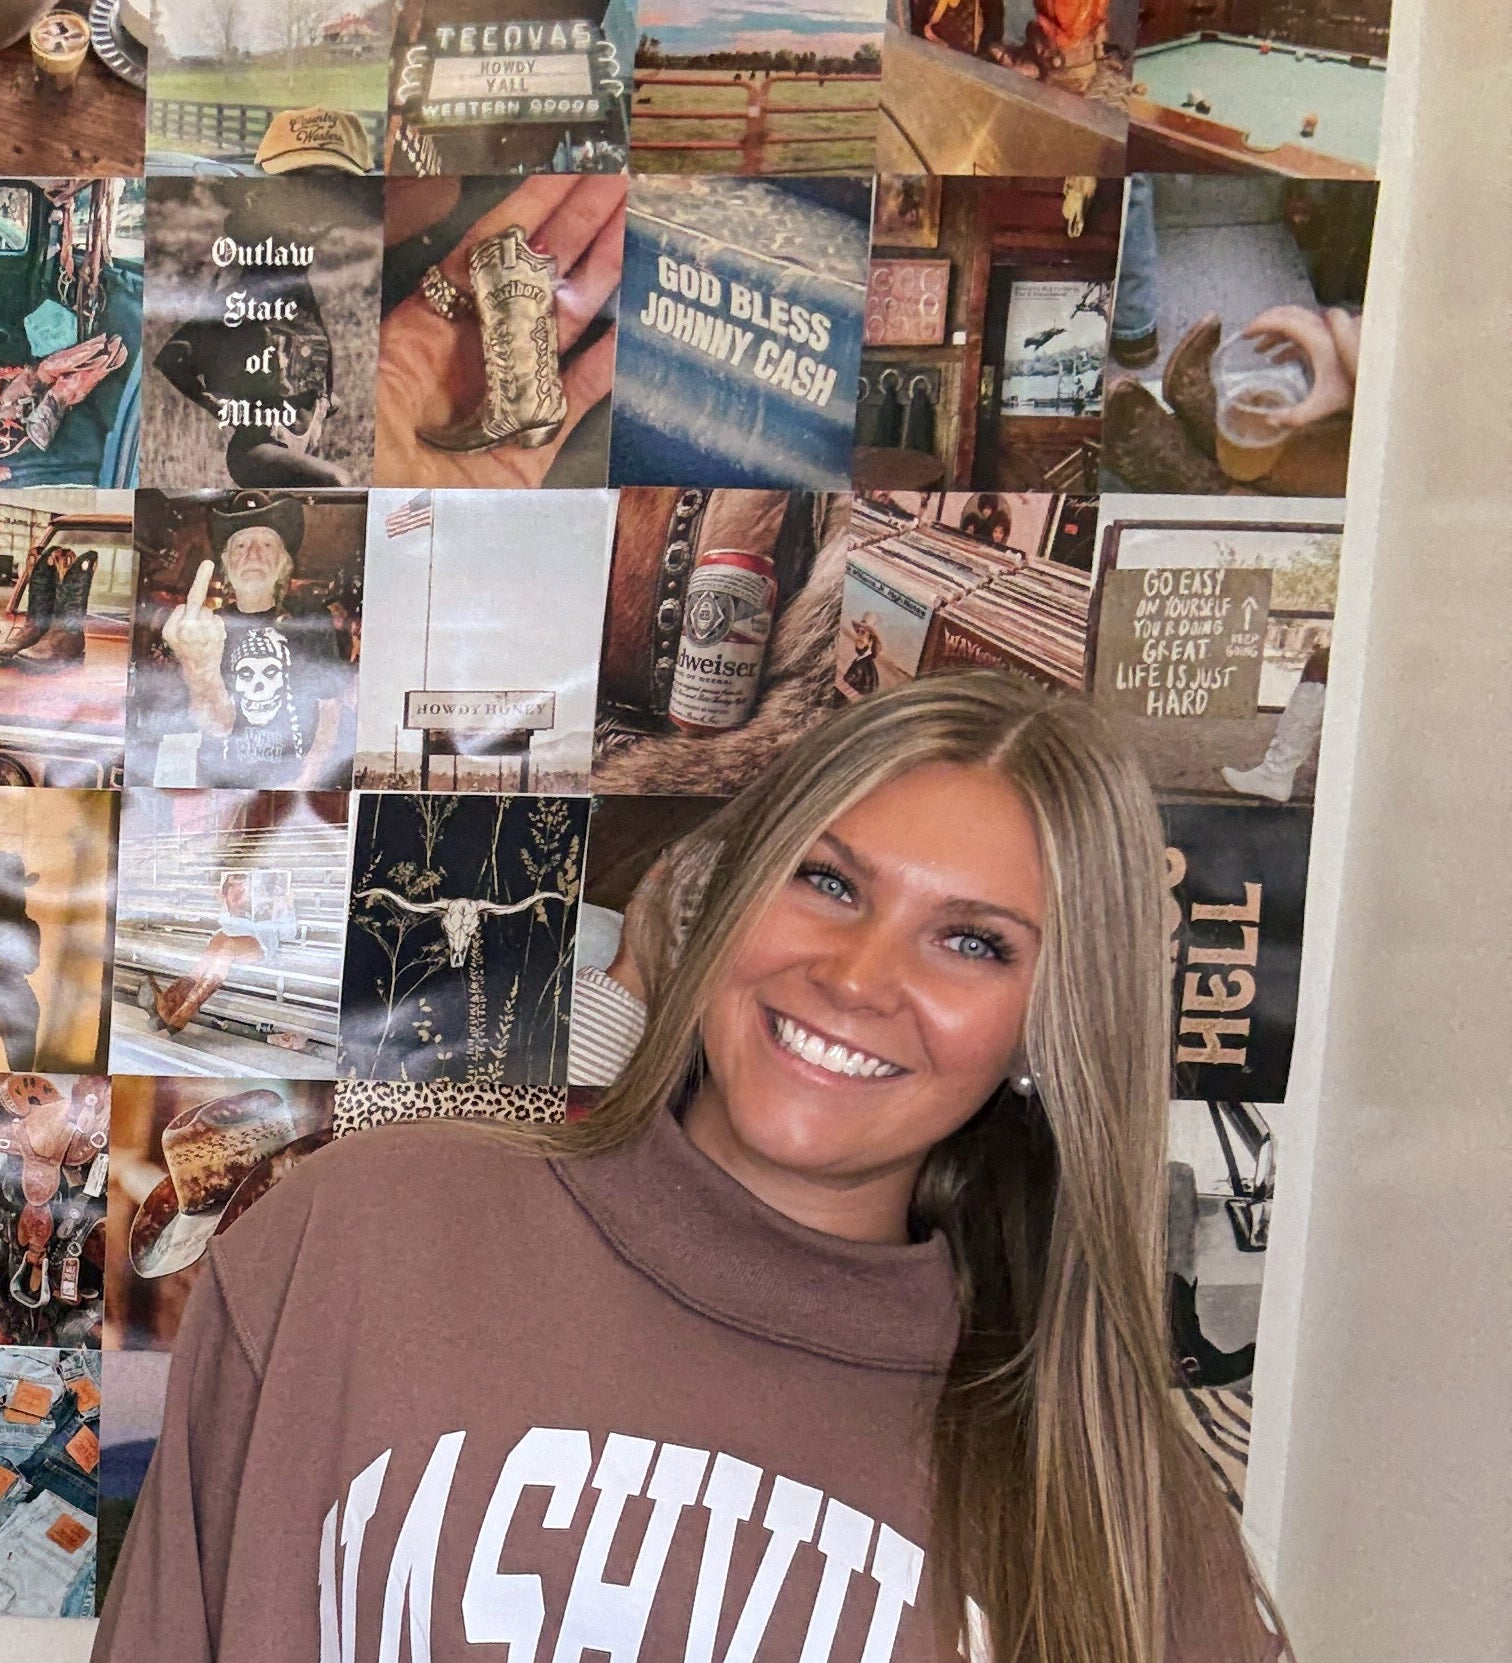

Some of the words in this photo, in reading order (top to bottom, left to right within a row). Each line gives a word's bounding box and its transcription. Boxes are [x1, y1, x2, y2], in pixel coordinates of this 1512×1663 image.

[436, 20, 591, 53] TECOVAS
[480, 59, 537, 75] HOWDY
[486, 77, 530, 94] YALL
[422, 100, 521, 123] WESTERN
[211, 235, 316, 268] Outlaw
[223, 288, 299, 329] State
[657, 255, 722, 308] GOD
[729, 281, 833, 353] BLESS
[244, 344, 277, 375] of
[640, 291, 755, 367] JOHNNY
[752, 338, 838, 408] CASH
[217, 397, 298, 431] Mind
[1143, 567, 1174, 597] GO
[1178, 568, 1226, 596] EASY
[1135, 598, 1160, 618] ON
[1164, 595, 1232, 618] YOURSELF
[1132, 618, 1162, 639] YOU
[677, 647, 760, 679] dweiser
[1141, 638, 1210, 665] GREAT
[1116, 661, 1161, 690] LIFE
[1165, 664, 1188, 689] IS
[1189, 665, 1238, 690] JUST
[416, 703, 481, 715] HOWDY
[1145, 688, 1210, 718] HARD
[1176, 881, 1263, 1066] HELL
